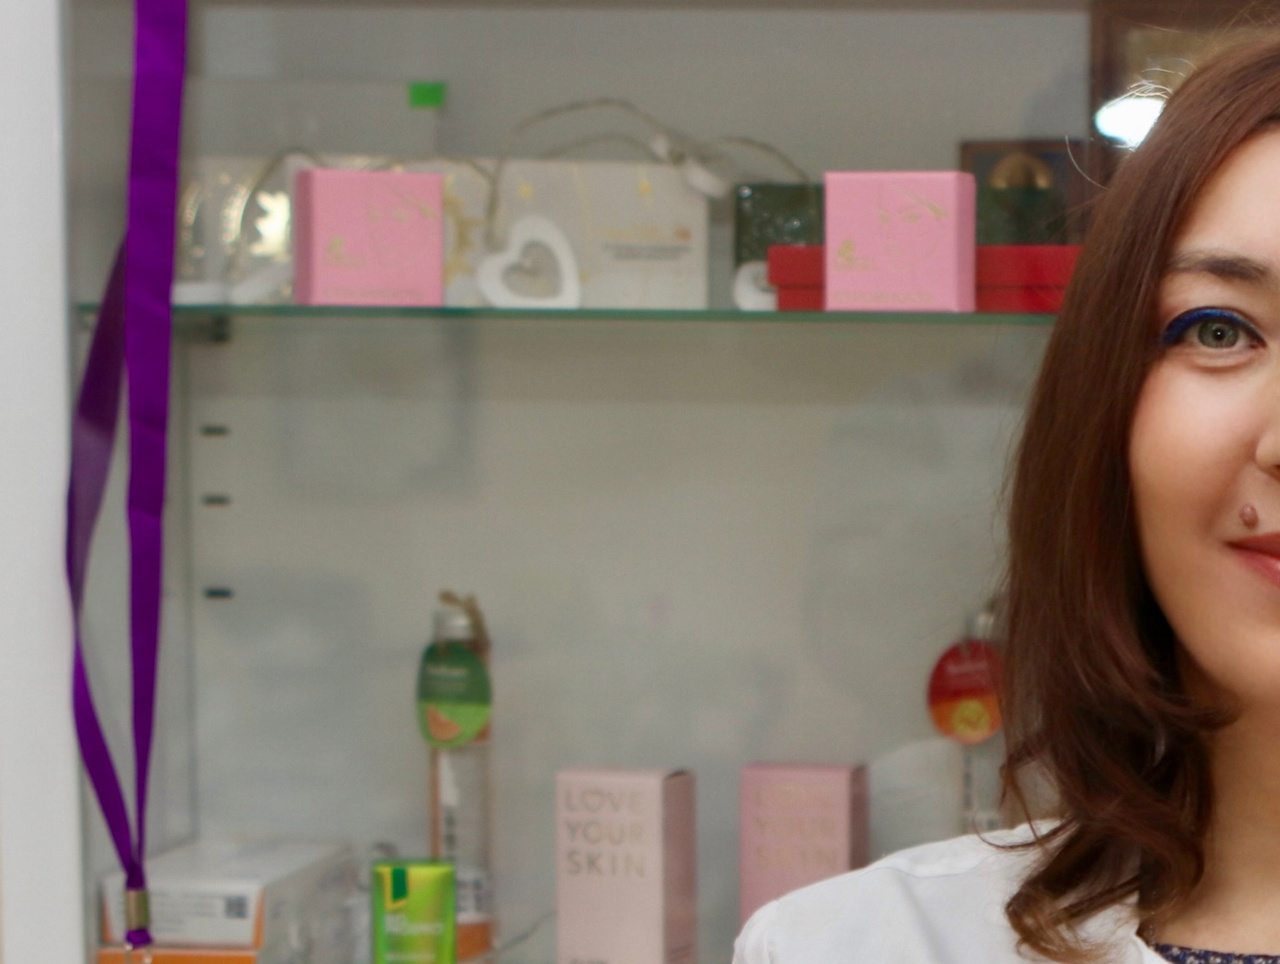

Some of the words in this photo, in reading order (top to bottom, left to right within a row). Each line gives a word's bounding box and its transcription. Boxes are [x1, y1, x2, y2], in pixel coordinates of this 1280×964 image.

[565, 789, 647, 813] LOVE
[565, 821, 646, 845] YOUR
[567, 851, 645, 876] SKIN
